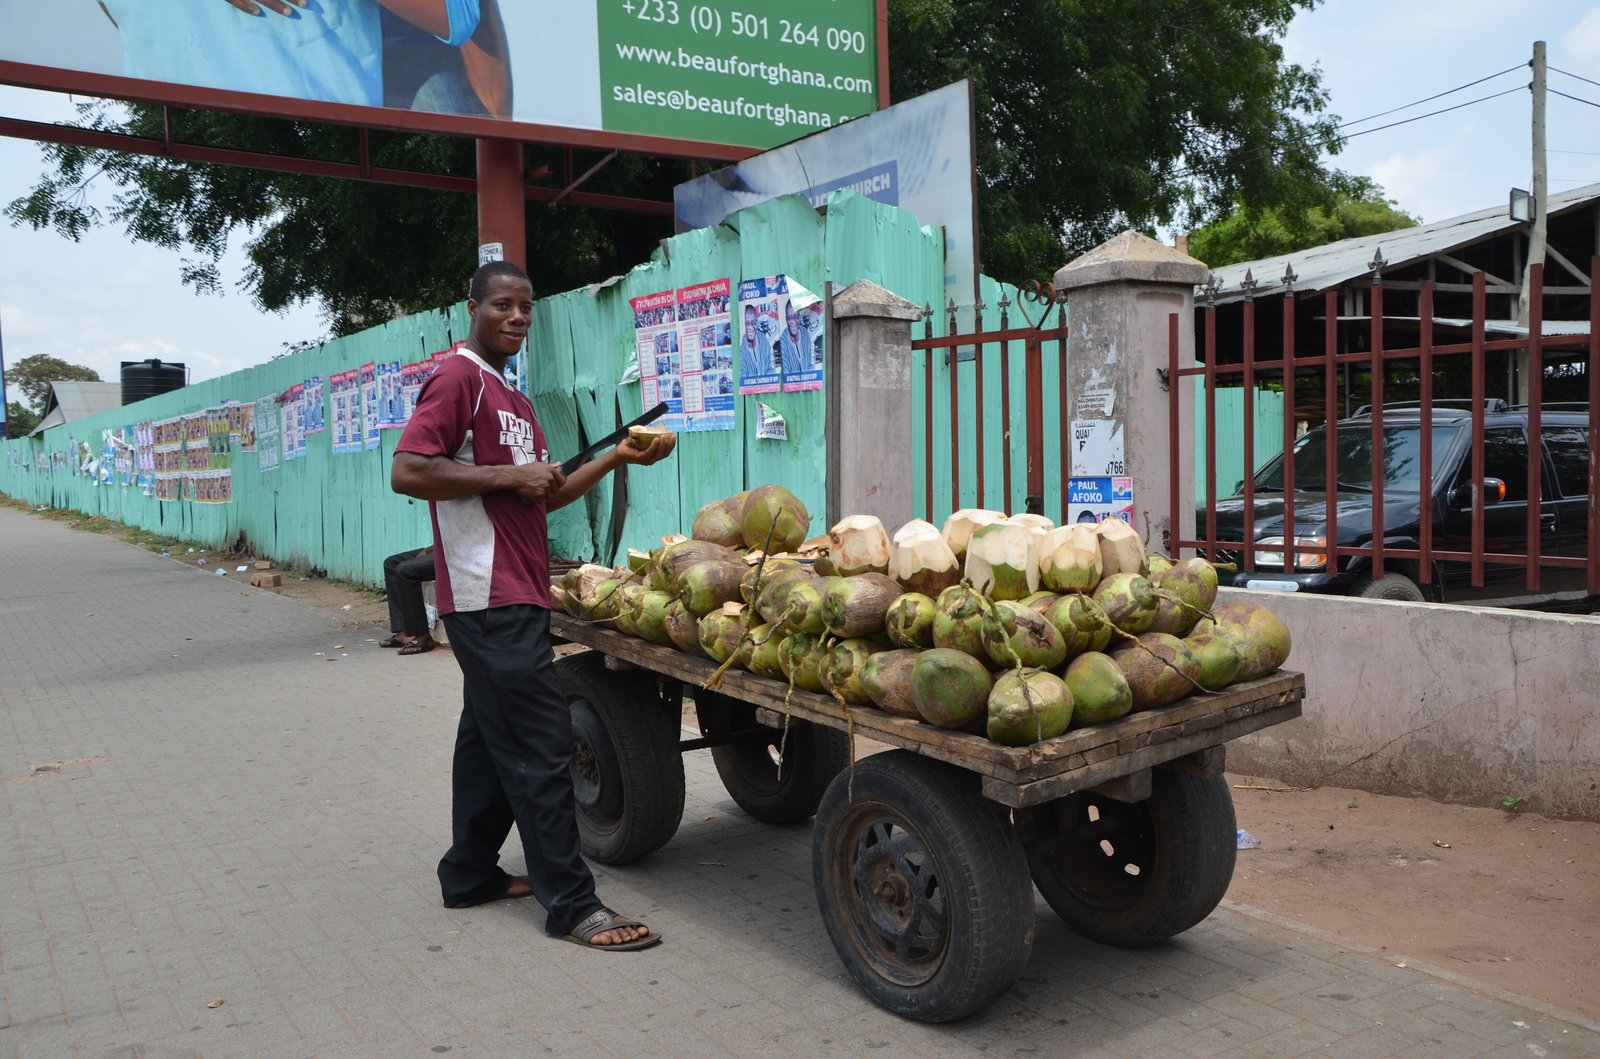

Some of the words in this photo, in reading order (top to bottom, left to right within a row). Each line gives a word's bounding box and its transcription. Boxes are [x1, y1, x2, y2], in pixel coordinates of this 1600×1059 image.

[622, 0, 680, 24] +233
[690, 5, 722, 37] (0)
[731, 11, 768, 40] 501
[779, 19, 820, 48] 264
[826, 27, 865, 54] 090
[615, 43, 873, 94] www.beaufortghana.com
[613, 83, 856, 127] sales@beaufortghana.c
[1072, 492, 1103, 503] AFOKO
[1077, 481, 1098, 490] PAUL
